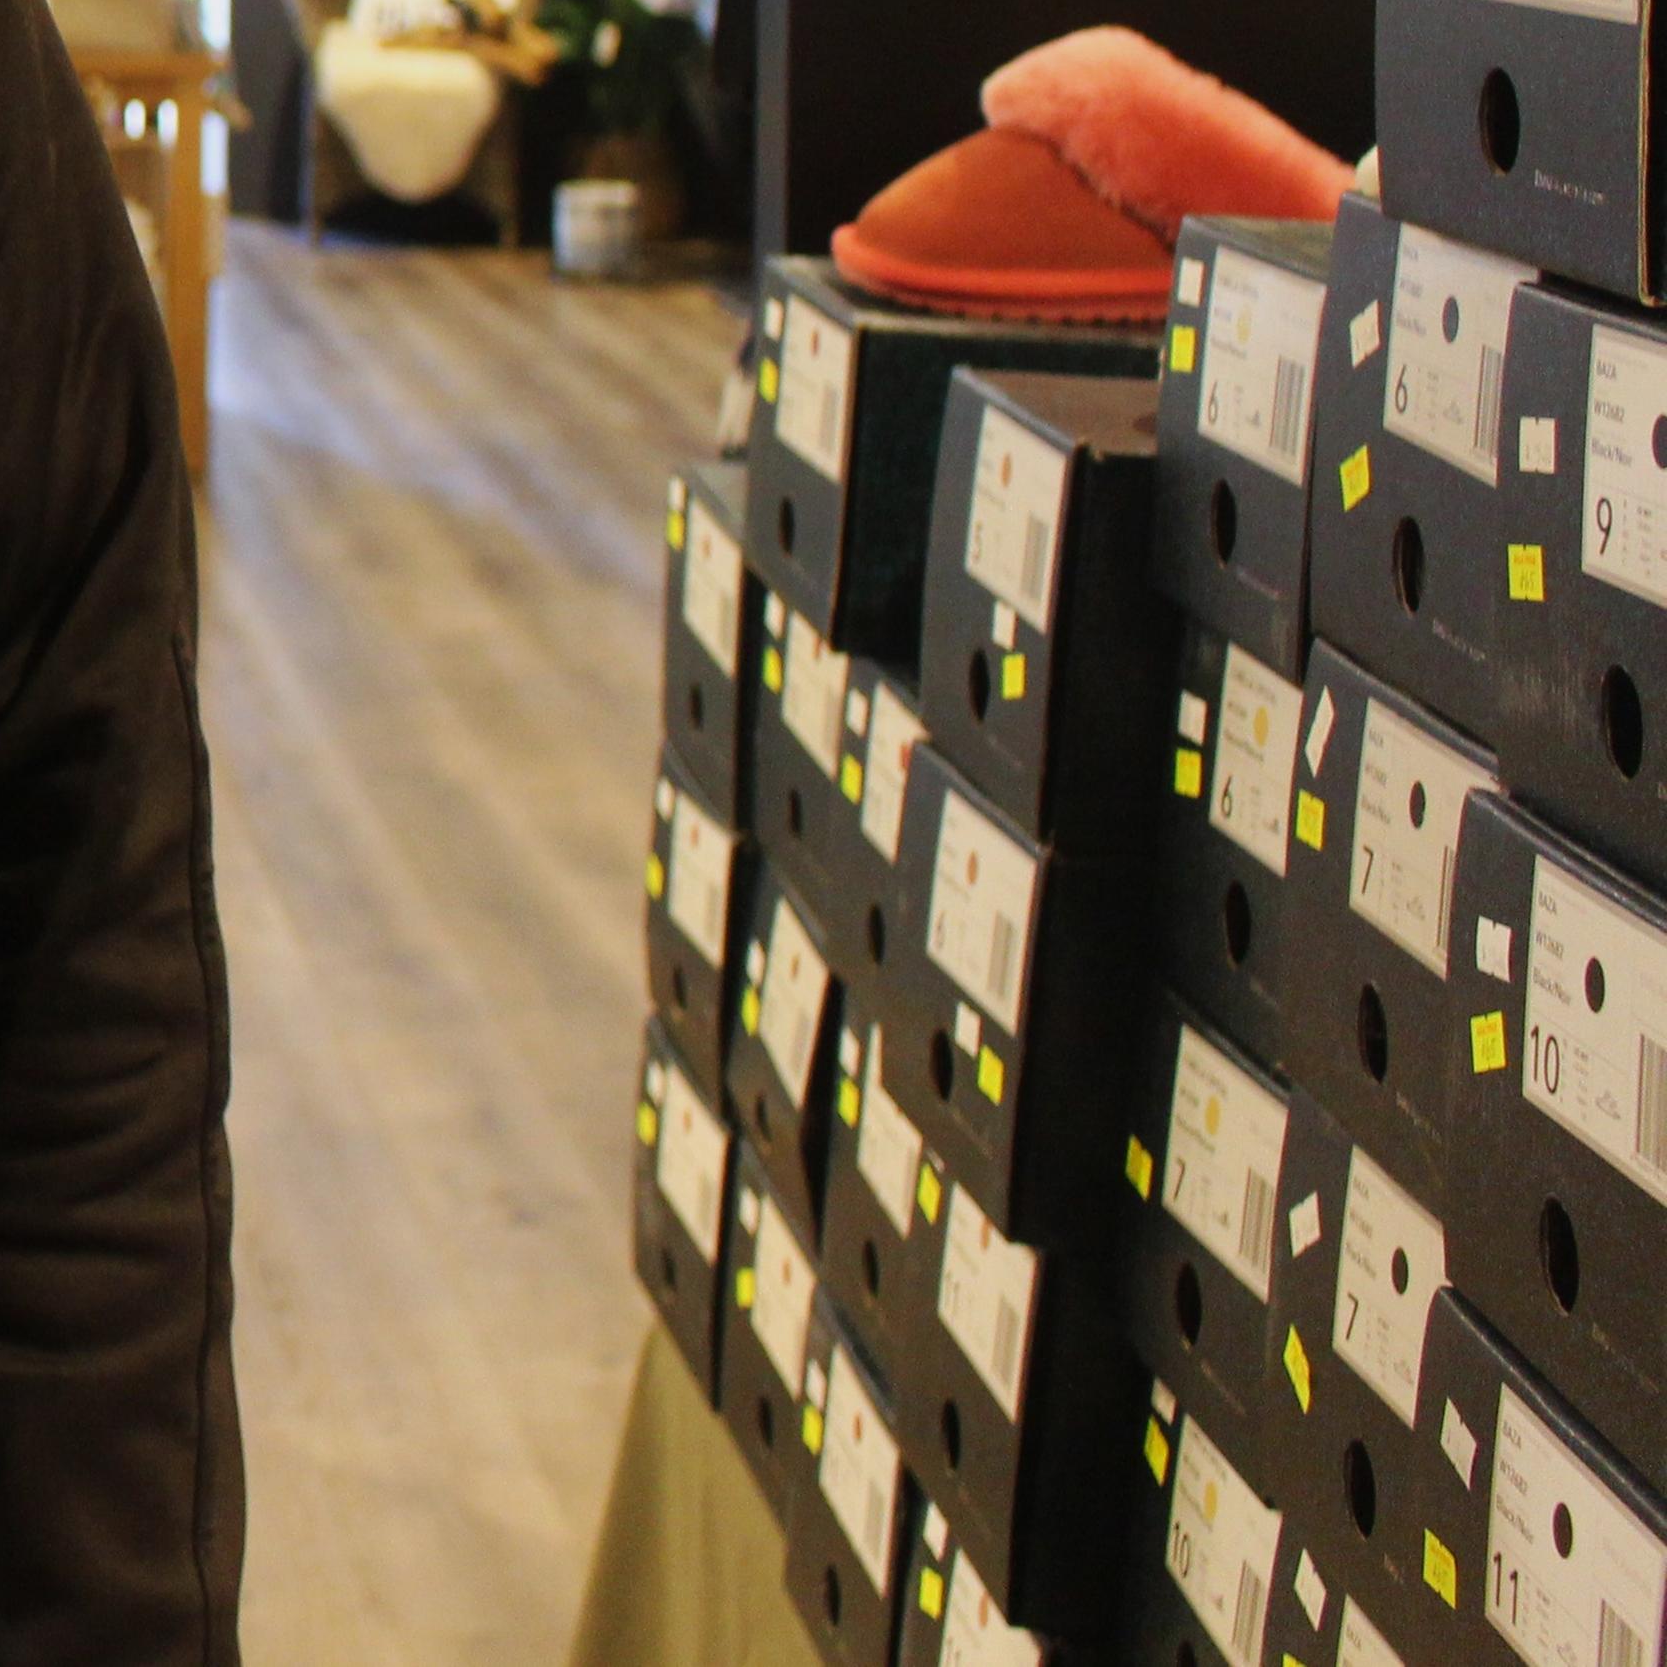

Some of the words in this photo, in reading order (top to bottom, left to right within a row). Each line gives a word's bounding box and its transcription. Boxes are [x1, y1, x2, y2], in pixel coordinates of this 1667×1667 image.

[1206, 380, 1220, 425] 6
[1393, 364, 1408, 415] 6
[1595, 496, 1614, 556] 9
[1219, 775, 1233, 820] 6
[1361, 844, 1375, 896] 7
[1530, 1024, 1561, 1096] 10
[1173, 1159, 1187, 1201] 7
[1345, 1291, 1360, 1341] 7
[1492, 1551, 1521, 1628] 11
